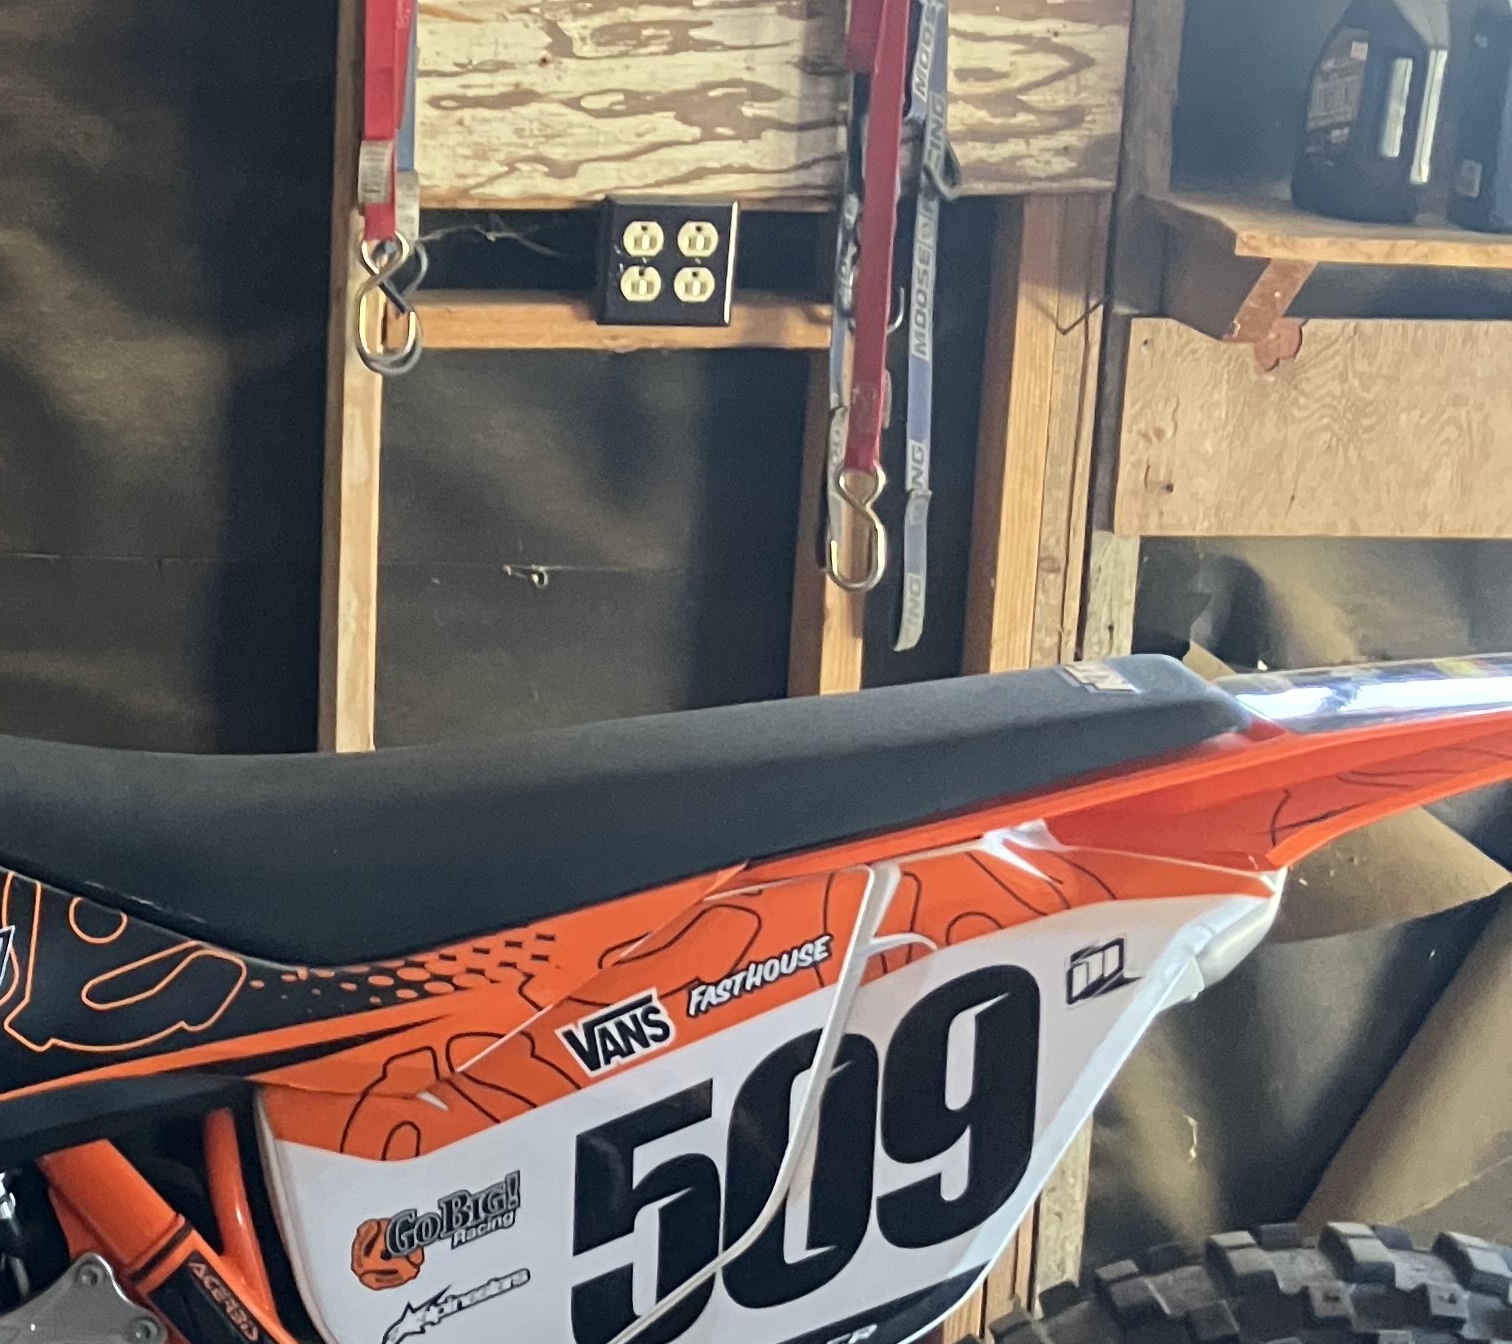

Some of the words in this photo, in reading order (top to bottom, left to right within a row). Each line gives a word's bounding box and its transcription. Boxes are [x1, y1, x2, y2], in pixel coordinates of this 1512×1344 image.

[687, 935, 832, 1018] FASTHOUSE
[562, 994, 671, 1071] VANS
[452, 1210, 516, 1248] Racing
